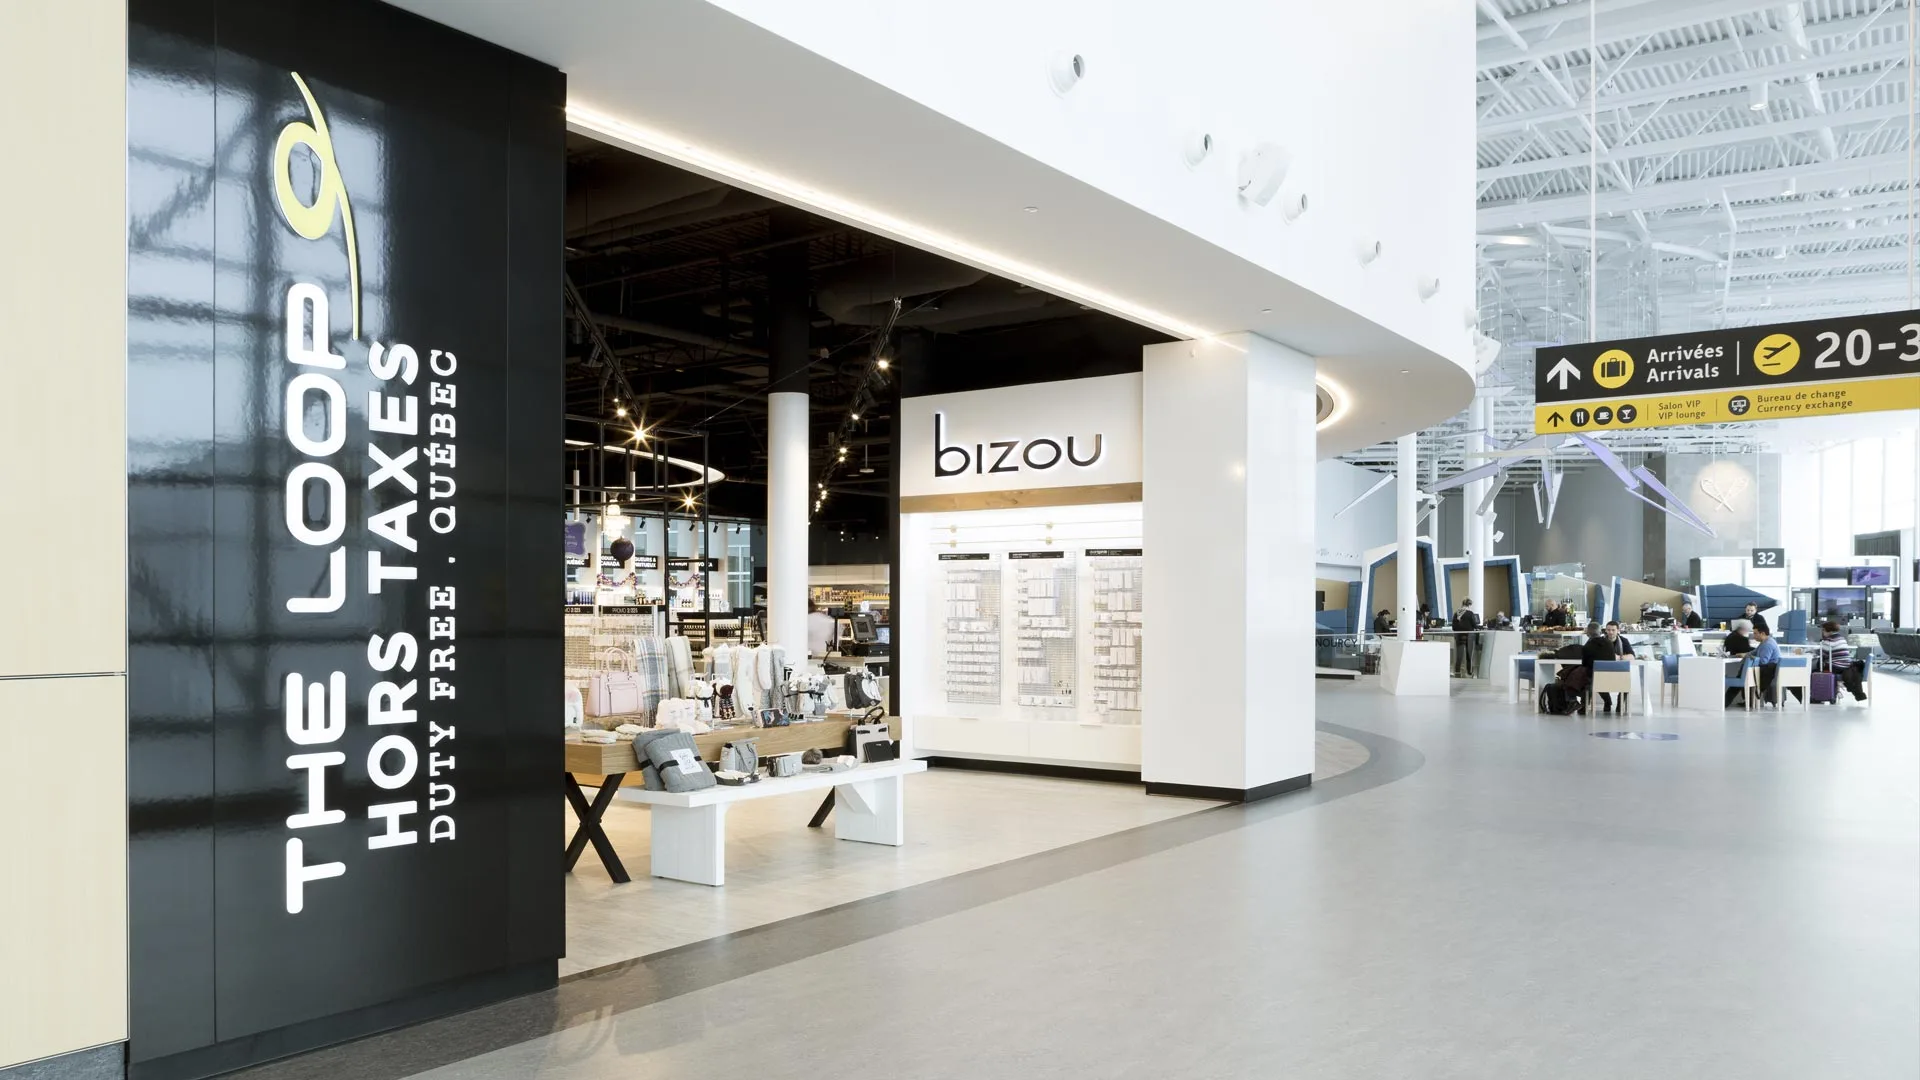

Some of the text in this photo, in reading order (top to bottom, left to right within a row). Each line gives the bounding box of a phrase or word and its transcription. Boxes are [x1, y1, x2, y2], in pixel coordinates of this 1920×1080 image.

[1646, 344, 1724, 363] Arrivées
[1646, 363, 1719, 383] Arrivals
[1795, 392, 1807, 400] de
[1810, 390, 1846, 399] change
[1658, 400, 1701, 411] Salon VIP
[1658, 411, 1706, 420] VIP lounge
[1757, 400, 1853, 413] Currency exchange
[423, 349, 457, 534] QUÉBEC
[934, 413, 1103, 478] bizou
[1757, 551, 1776, 565] 32
[286, 282, 346, 914] THE LOOP
[367, 341, 418, 850] HORS TAXES
[429, 586, 456, 700] FREE
[429, 721, 456, 842] DUTY
